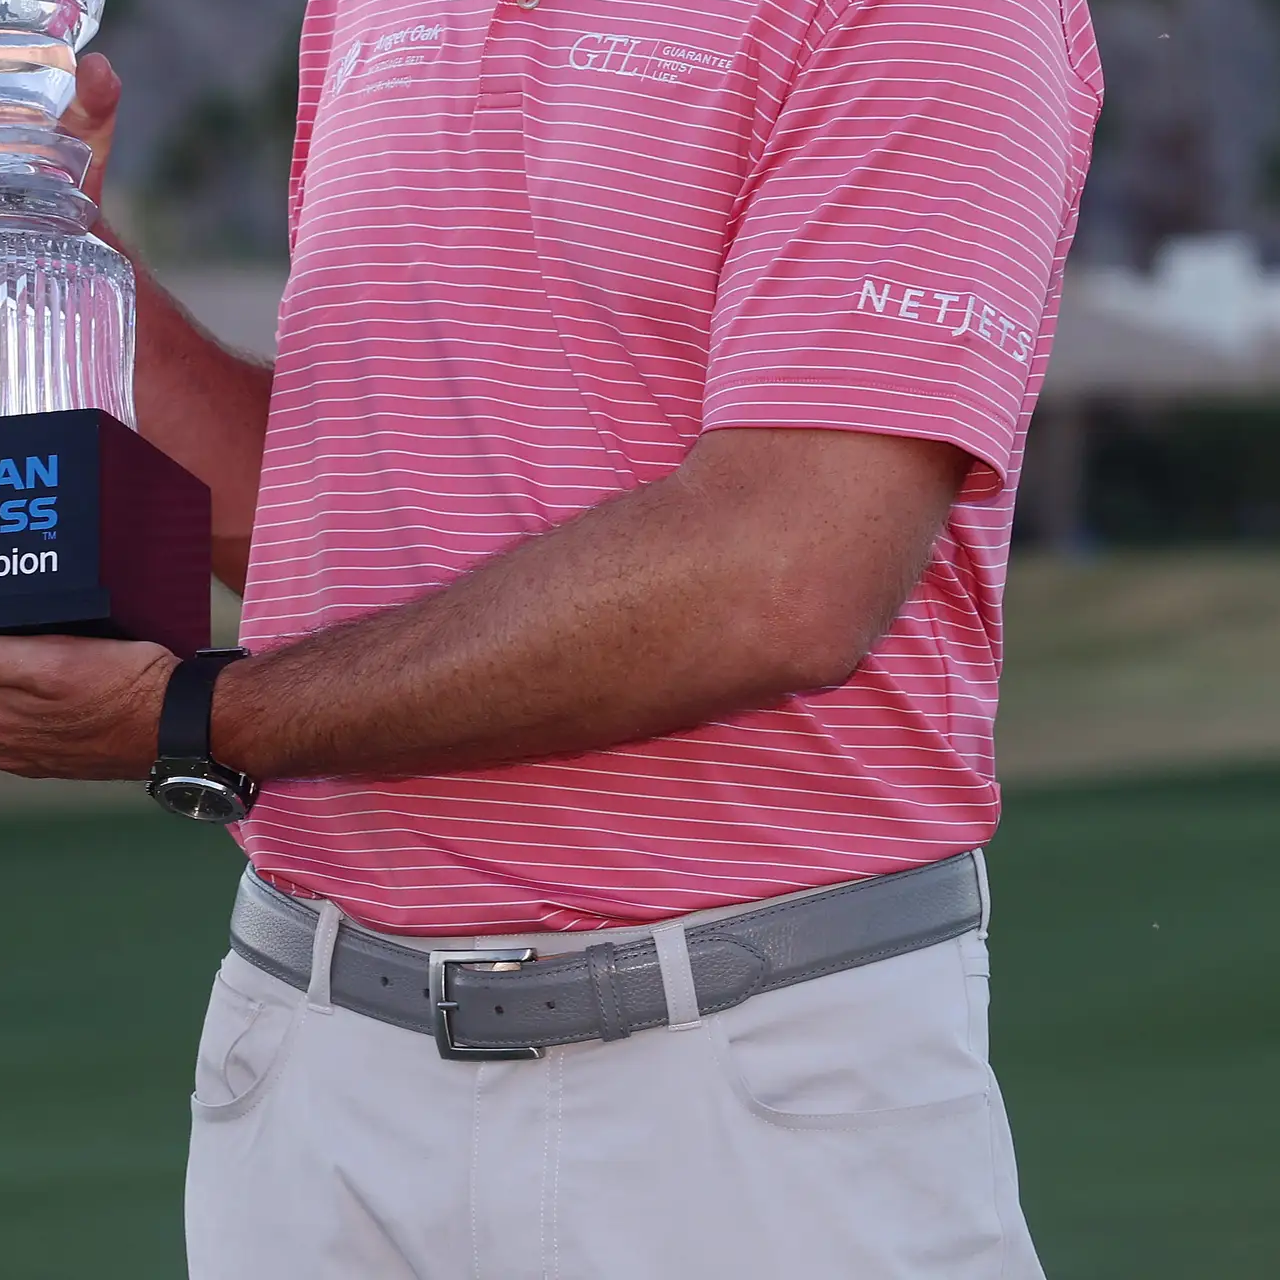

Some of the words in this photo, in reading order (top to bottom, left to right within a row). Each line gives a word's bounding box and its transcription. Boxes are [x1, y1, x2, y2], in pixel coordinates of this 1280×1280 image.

[569, 32, 641, 77] GTL
[662, 46, 734, 70] GUARANTEE
[651, 70, 678, 82] LIFE
[657, 59, 694, 75] TRUST
[856, 279, 1034, 363] NETJETS
[42, 531, 57, 541] TM
